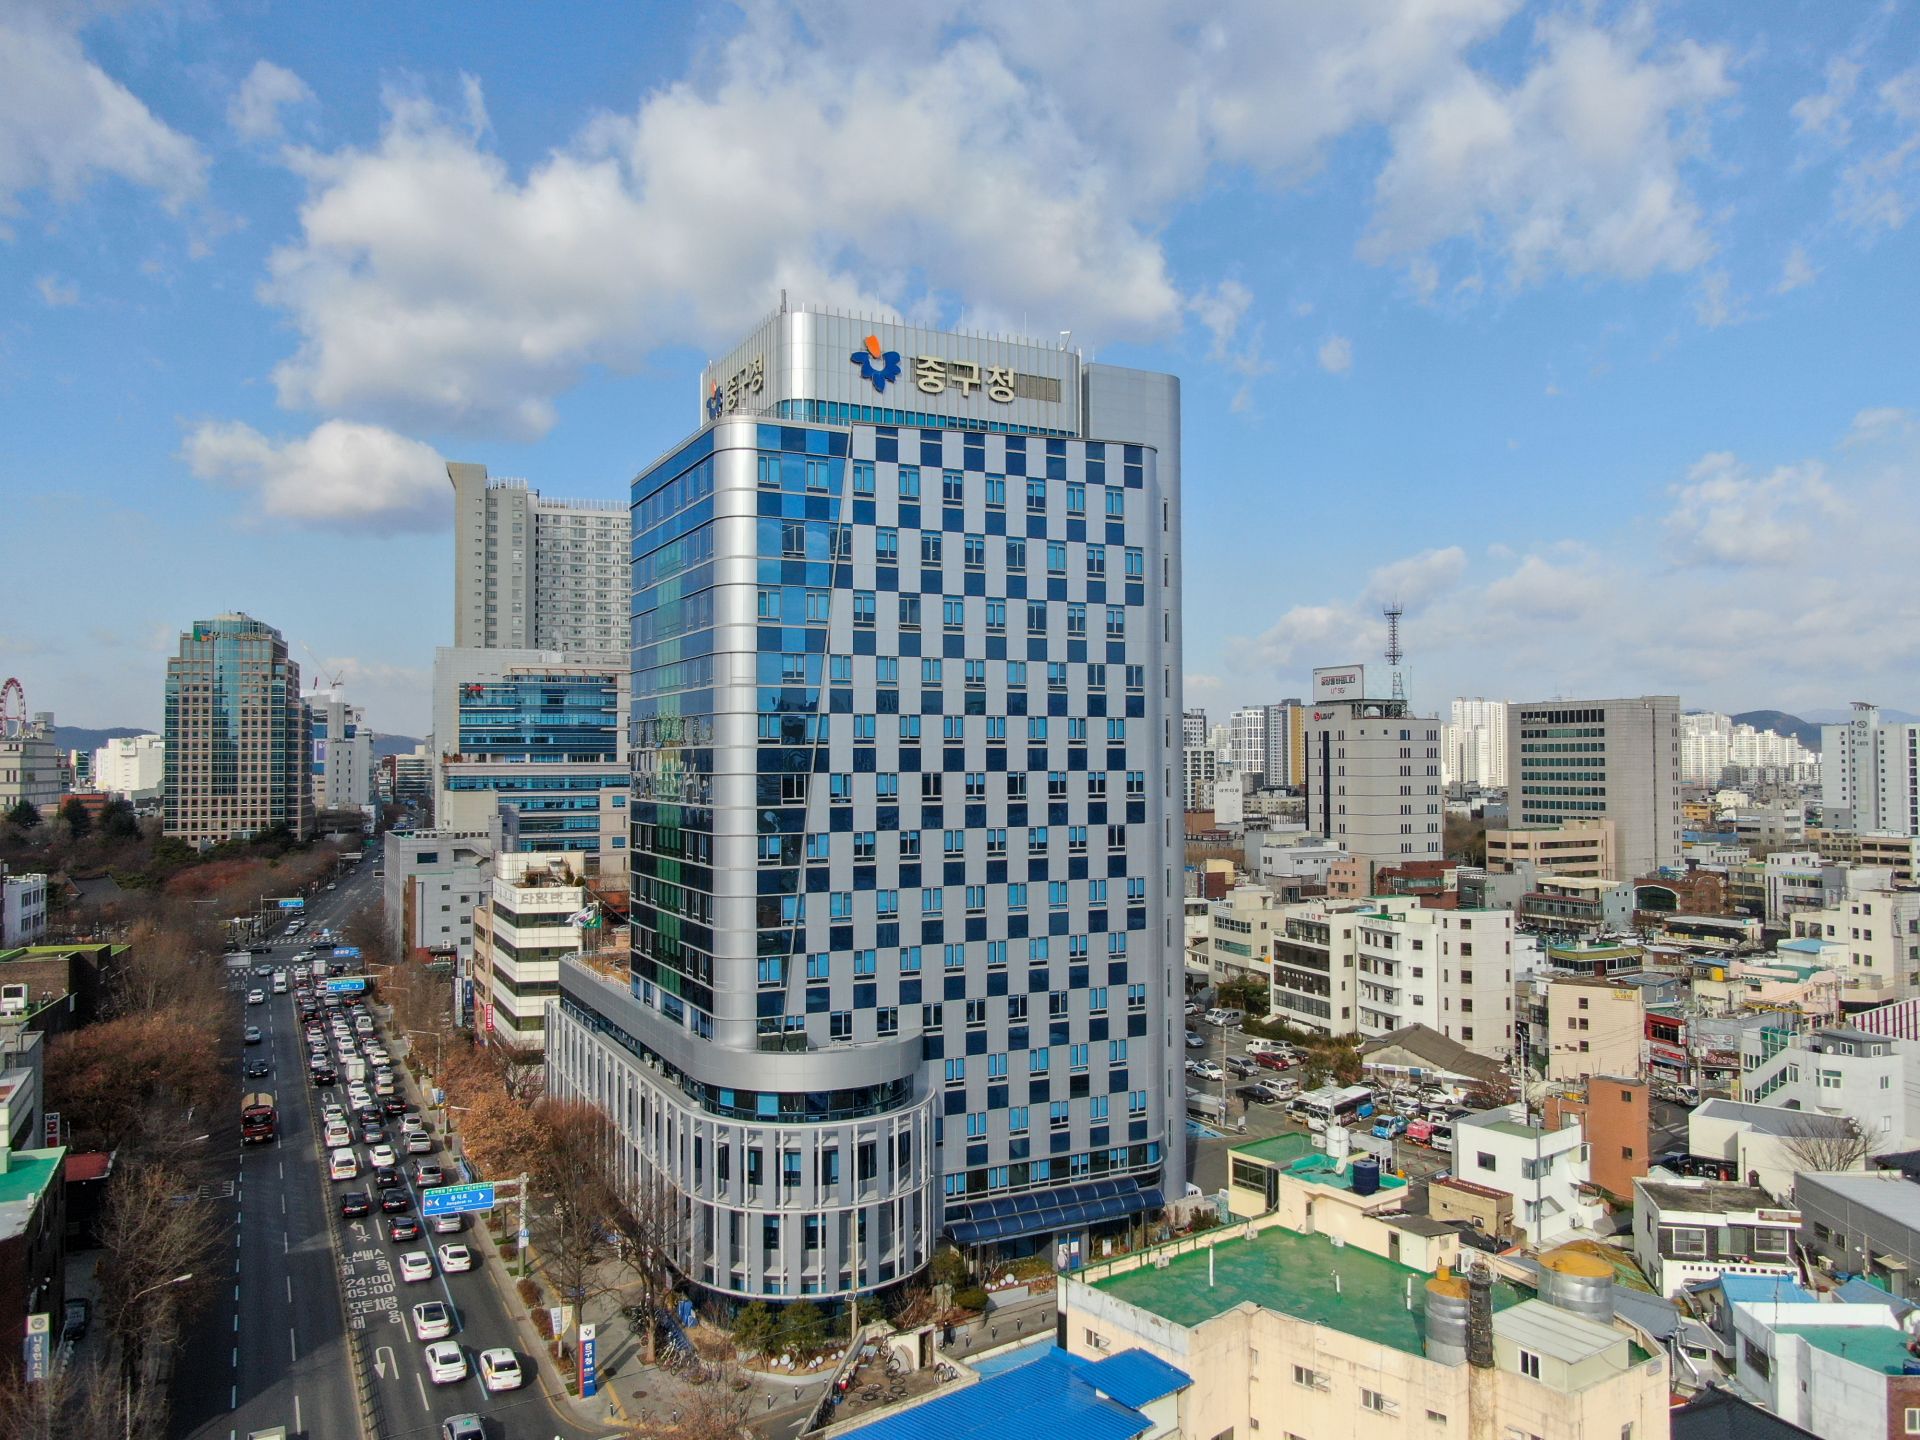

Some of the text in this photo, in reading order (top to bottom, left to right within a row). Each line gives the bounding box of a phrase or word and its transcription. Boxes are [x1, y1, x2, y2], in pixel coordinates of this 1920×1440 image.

[726, 351, 763, 411] 중구청
[916, 355, 1015, 402] 중구청
[345, 1273, 390, 1288] 24:00
[347, 1283, 394, 1298] 05:00
[349, 1295, 398, 1315] 모든차량
